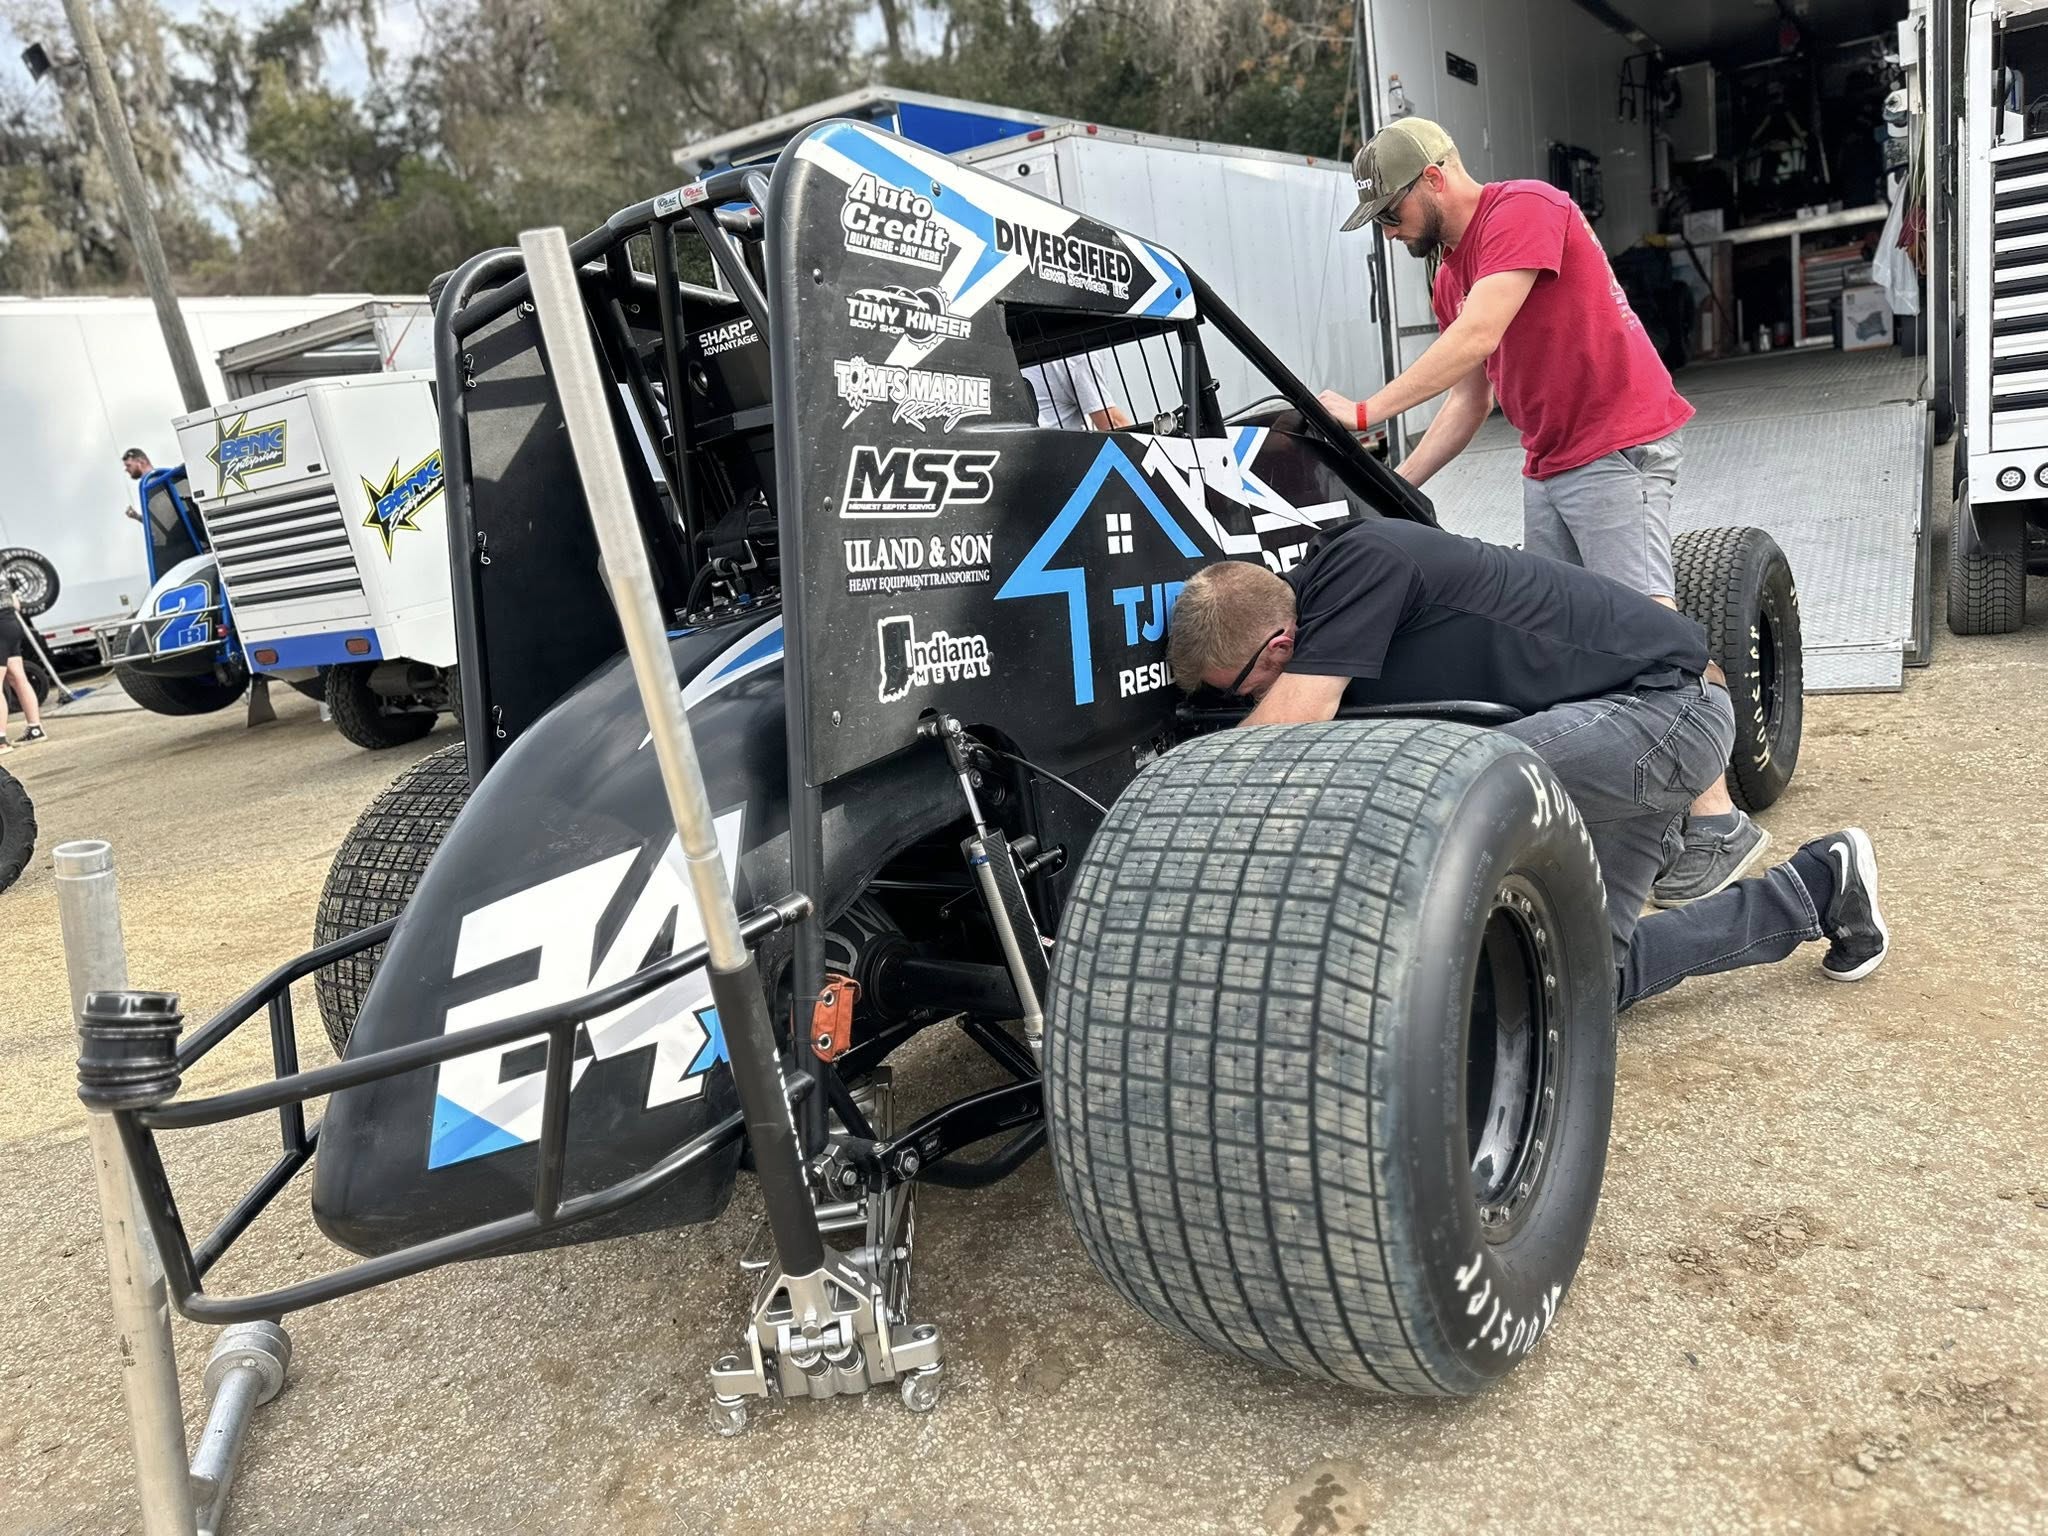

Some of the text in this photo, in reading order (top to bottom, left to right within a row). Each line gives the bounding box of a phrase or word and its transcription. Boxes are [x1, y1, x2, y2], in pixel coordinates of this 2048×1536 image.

[849, 173, 934, 220] Auto
[842, 205, 950, 251] Credit
[848, 232, 942, 264] BUY HERE PAY HERE
[995, 217, 1131, 283] DIVERSIFIED
[1039, 267, 1130, 300] Lawn Services, LLC
[699, 319, 754, 348] SHARP
[847, 299, 972, 338] TONY KINSER
[849, 318, 905, 334] BODY SHOP
[703, 333, 759, 357] ADVANTAGE
[907, 369, 990, 408] MARINE
[893, 400, 972, 433] Racing
[220, 426, 284, 463] BENIC
[376, 457, 443, 522] BENIC
[845, 447, 998, 503] MSS
[844, 534, 993, 573] ULAND & SON
[848, 568, 990, 592] HEAVY EQUIPMENT TRANSPORTING
[905, 634, 986, 668] Indiana
[916, 661, 988, 683] METAL
